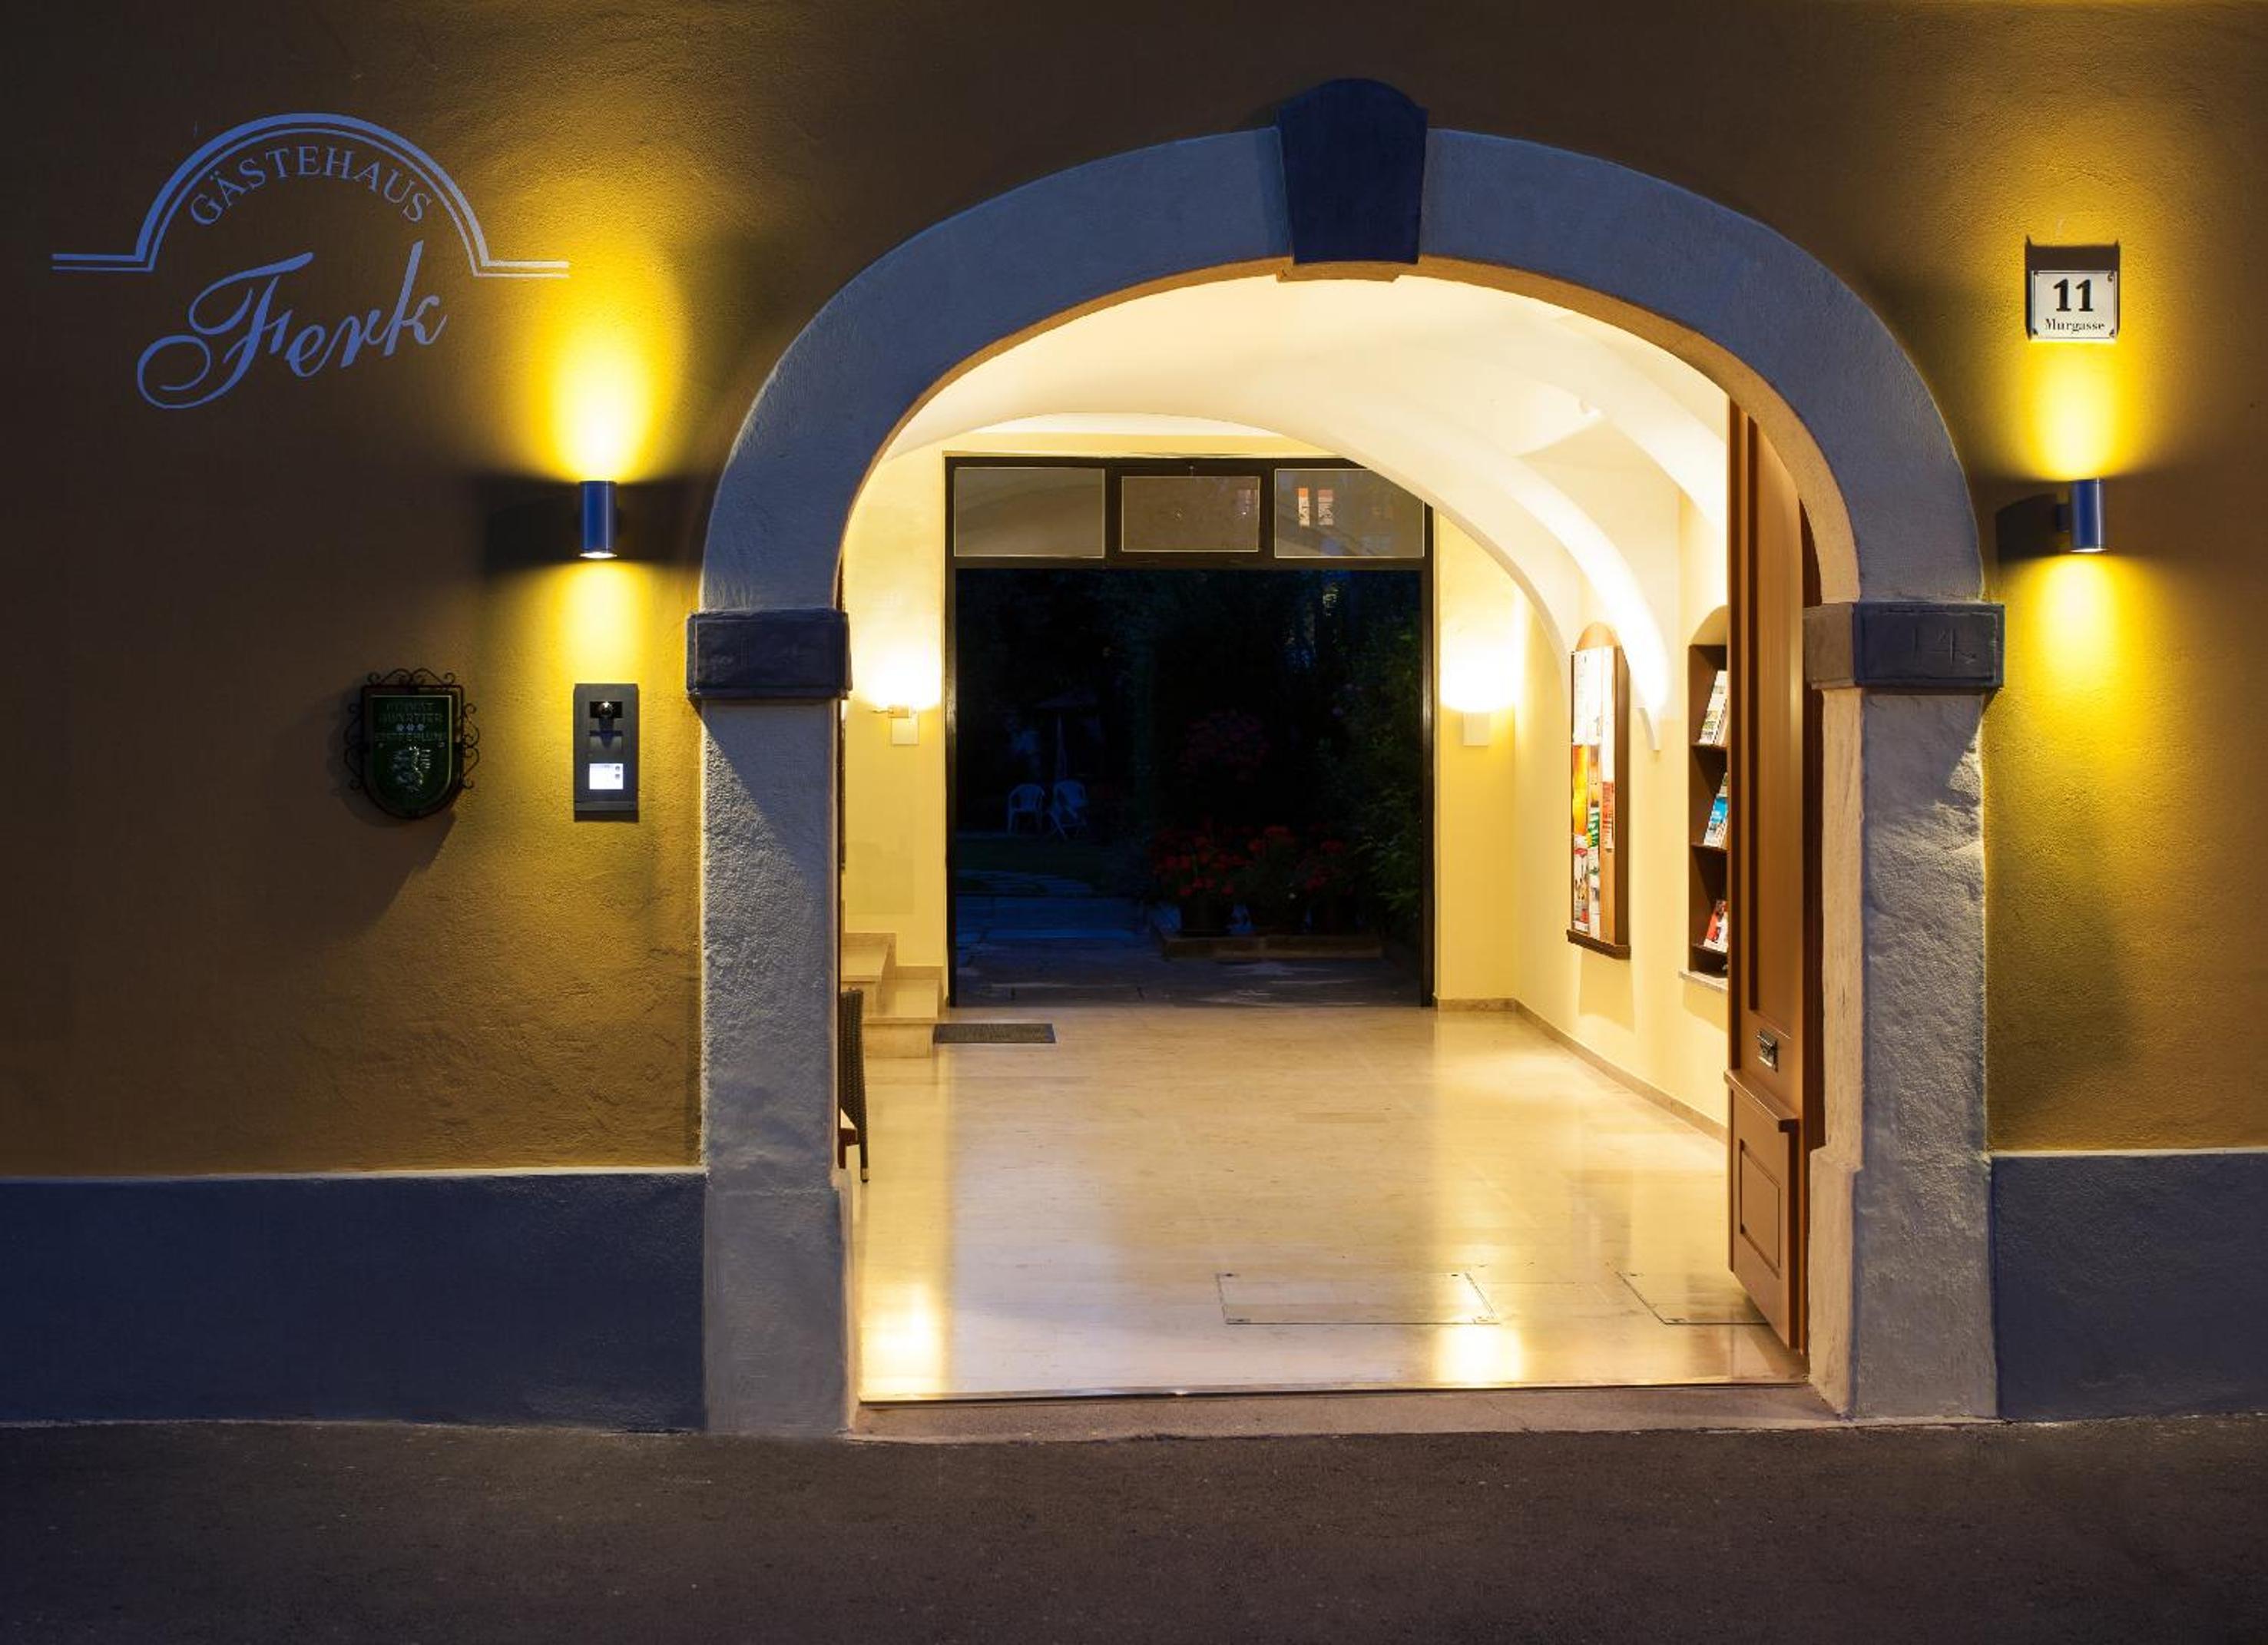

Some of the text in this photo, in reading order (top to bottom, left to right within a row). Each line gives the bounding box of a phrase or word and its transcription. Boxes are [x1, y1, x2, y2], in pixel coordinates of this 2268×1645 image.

[190, 146, 432, 225] GÄSTEHAUS
[2054, 279, 2094, 312] 11
[137, 240, 448, 409] Ferk
[2045, 319, 2105, 333] Murgasse
